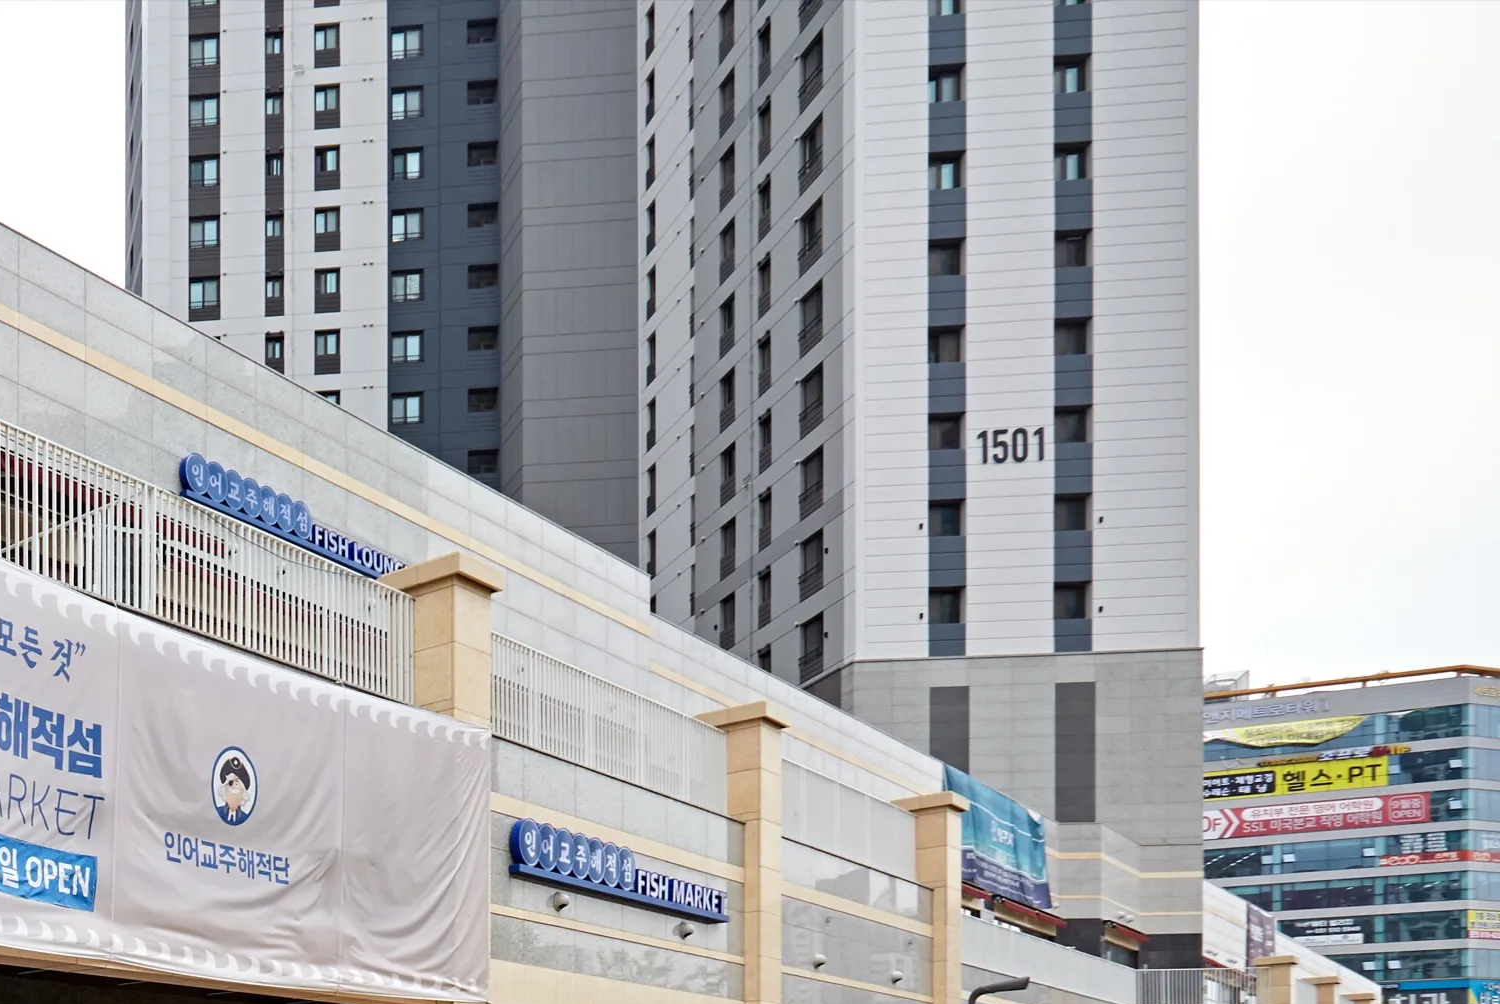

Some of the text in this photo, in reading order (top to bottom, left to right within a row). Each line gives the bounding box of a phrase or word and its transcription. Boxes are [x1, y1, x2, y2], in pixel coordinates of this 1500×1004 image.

[977, 427, 1044, 464] 1501
[192, 464, 408, 574] 인어교주해적섬 FISH LOUN
[51, 638, 87, 682] 것”
[1243, 822, 1267, 833] SSL
[1392, 809, 1421, 819] OPEN
[26, 856, 91, 898] OPEN
[164, 831, 290, 885] 인어교주해적단
[524, 829, 728, 916] 인어교주해적섬 FISH MARKET
